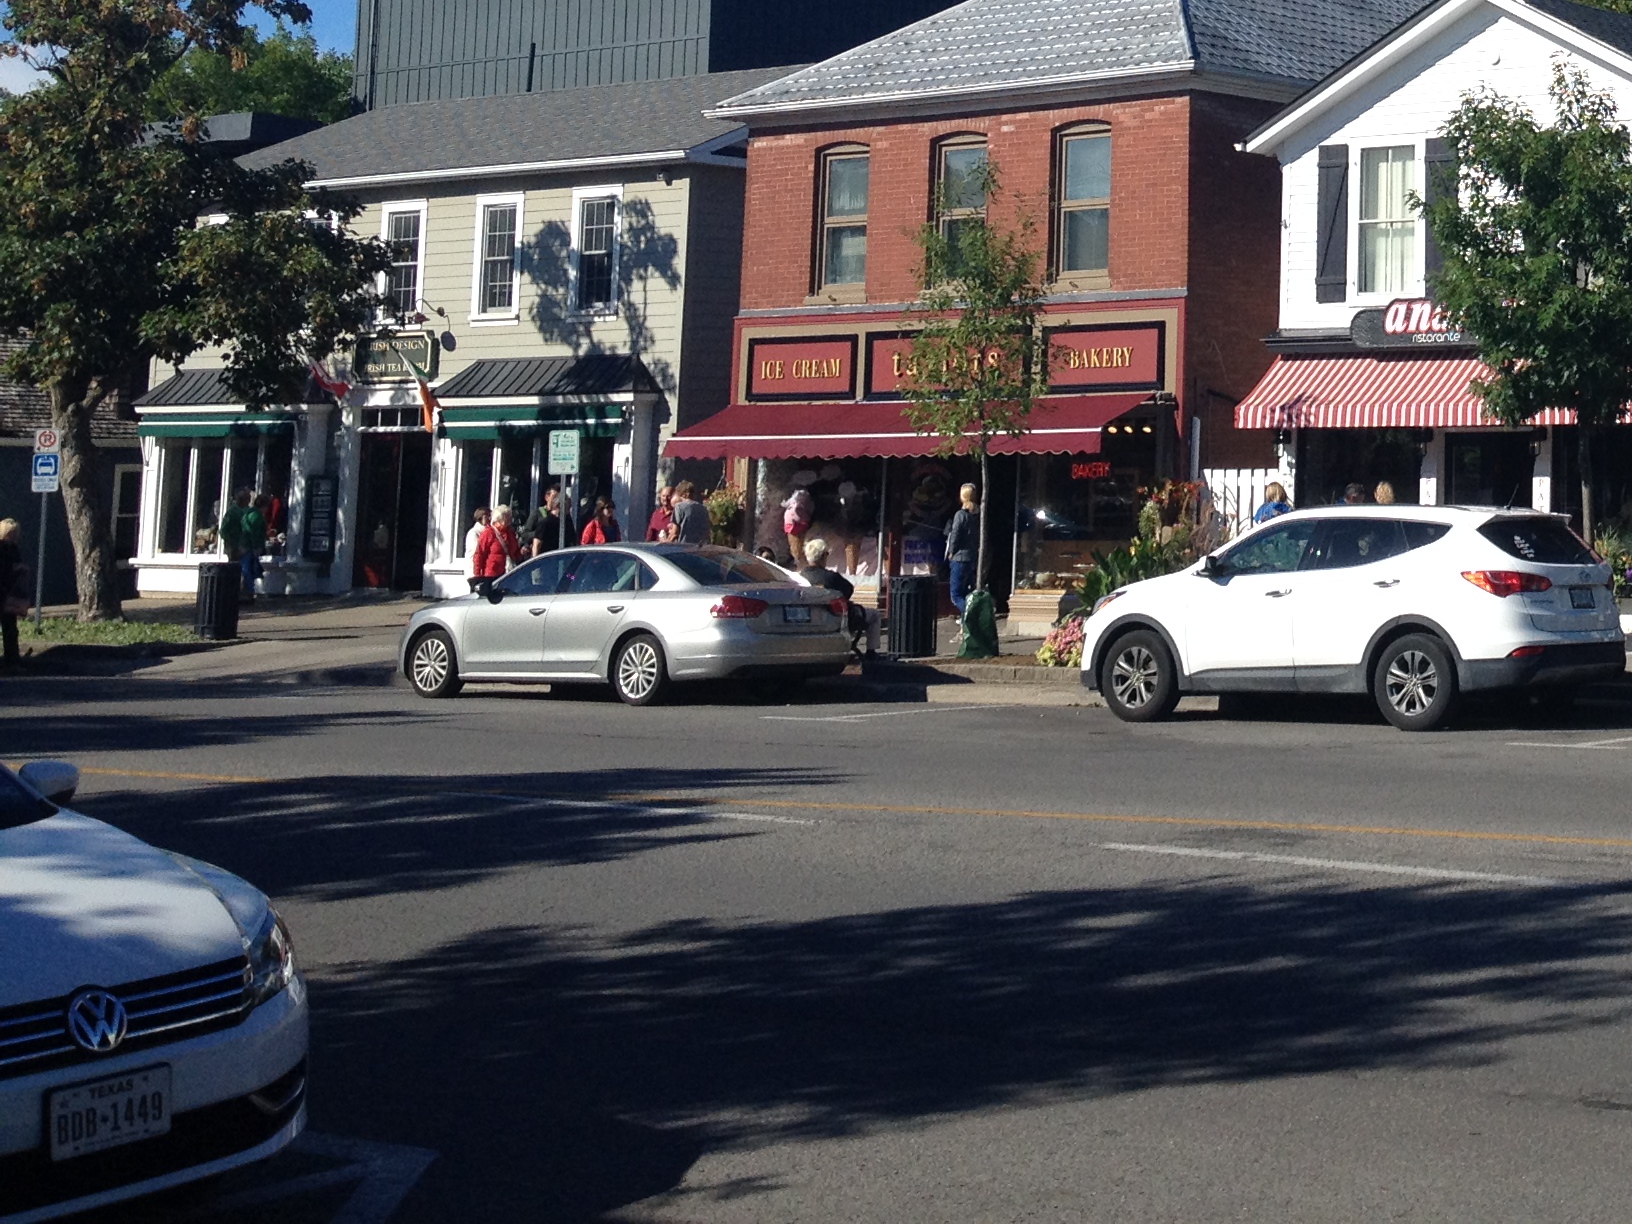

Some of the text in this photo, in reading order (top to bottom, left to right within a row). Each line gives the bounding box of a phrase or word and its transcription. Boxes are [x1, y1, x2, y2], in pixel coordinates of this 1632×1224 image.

[1412, 332, 1461, 343] ristorante
[387, 362, 401, 372] TEA
[1069, 346, 1134, 369] BAKERY
[760, 357, 842, 380] ICE CREAM
[1070, 461, 1111, 480] BAKERY
[89, 1078, 134, 1101] TEXAS
